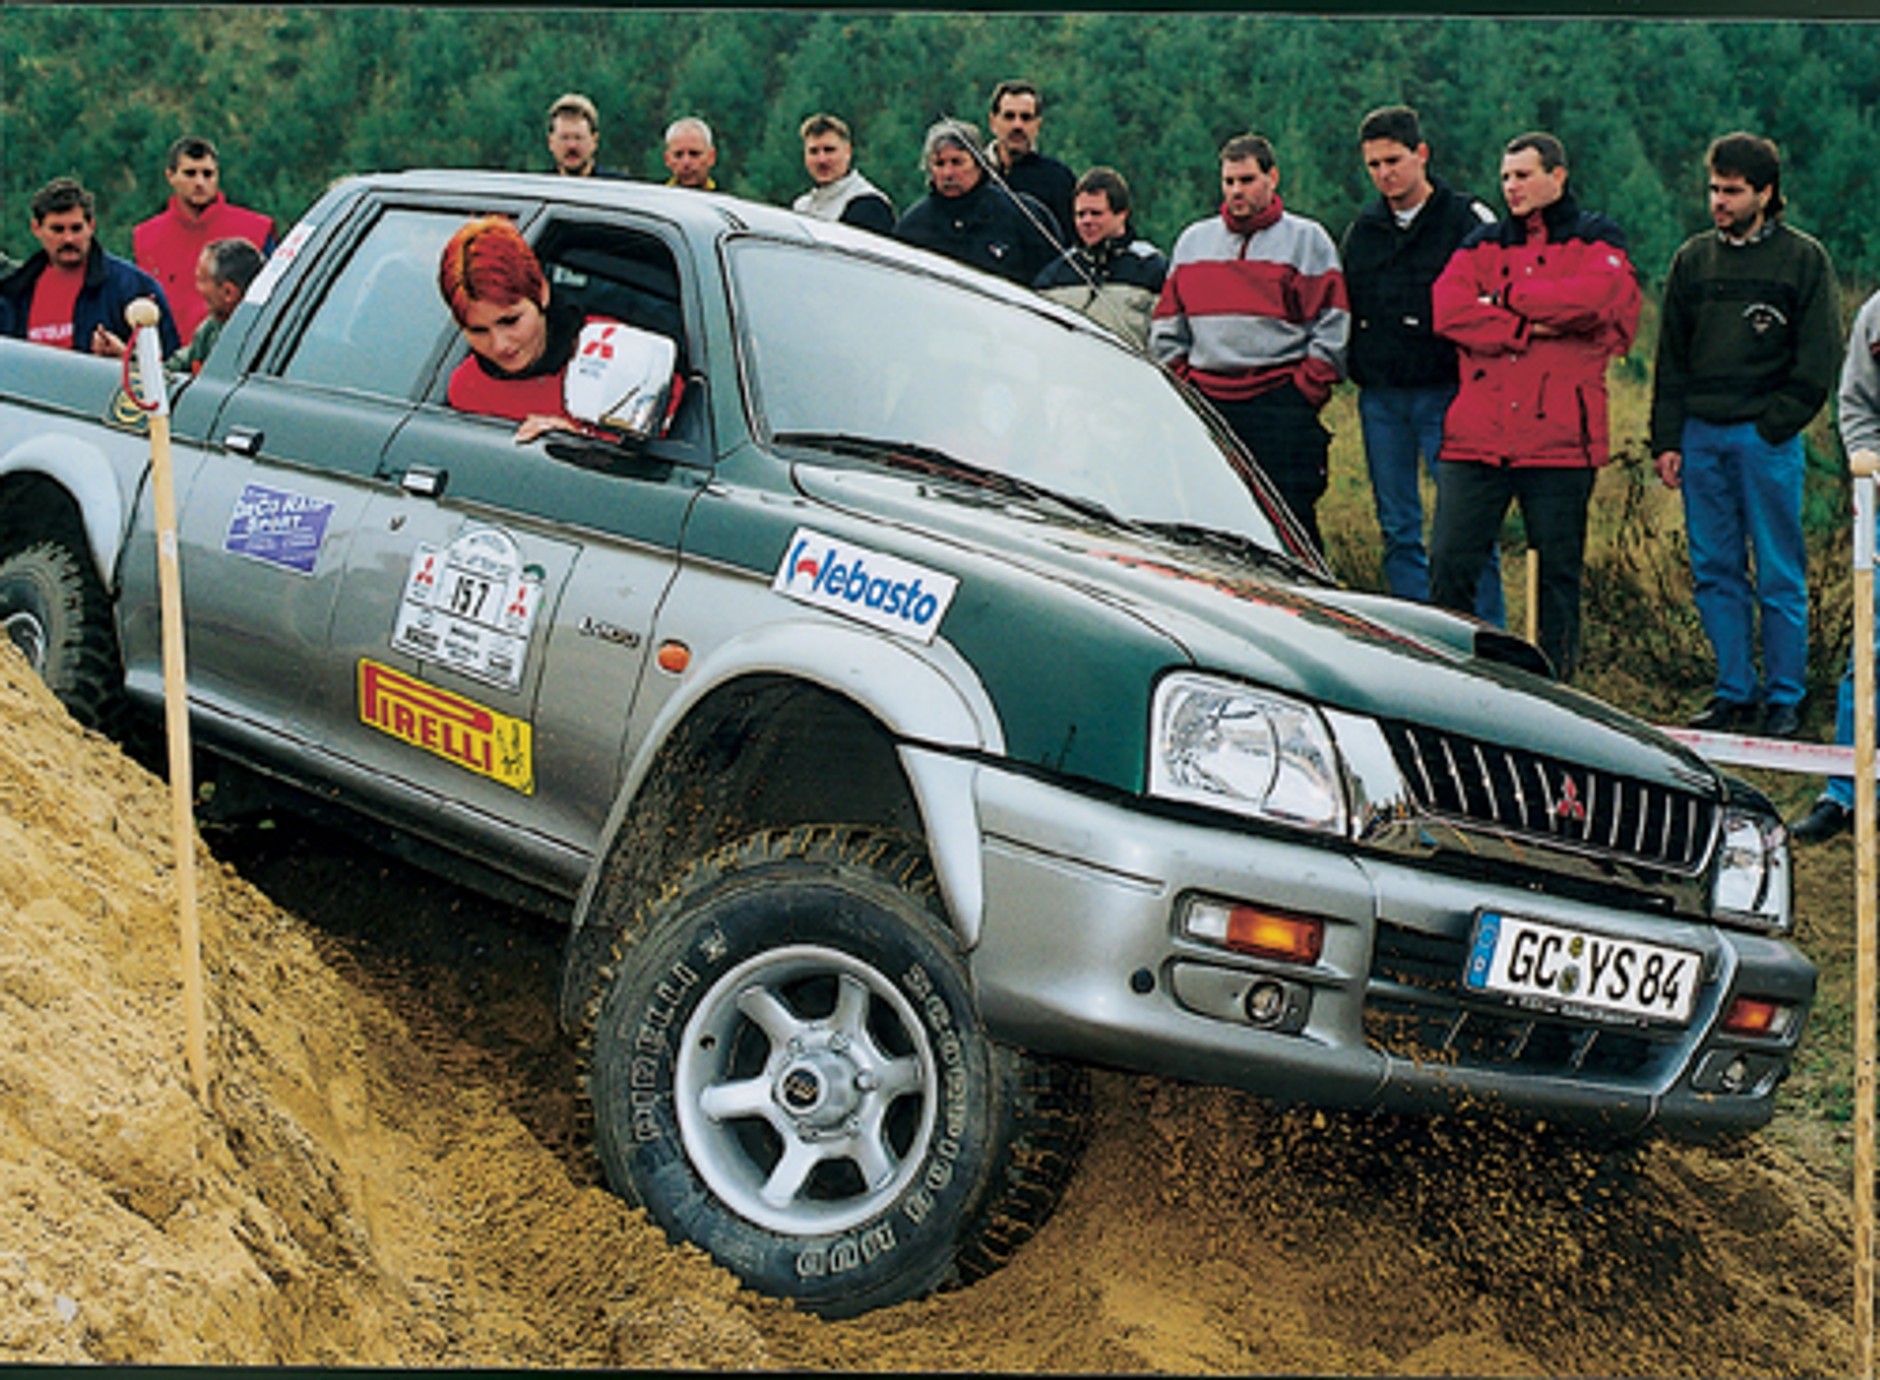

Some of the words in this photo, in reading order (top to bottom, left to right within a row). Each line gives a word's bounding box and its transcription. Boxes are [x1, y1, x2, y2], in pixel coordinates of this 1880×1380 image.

[450, 575, 491, 618] 157
[786, 539, 938, 625] Webasto
[364, 662, 494, 773] PIRELLI
[1507, 928, 1562, 990] GC
[1587, 941, 1637, 1000] YS
[1637, 954, 1686, 1009] 84
[631, 961, 699, 1142] PIRELLI
[795, 1222, 898, 1277] MUD
